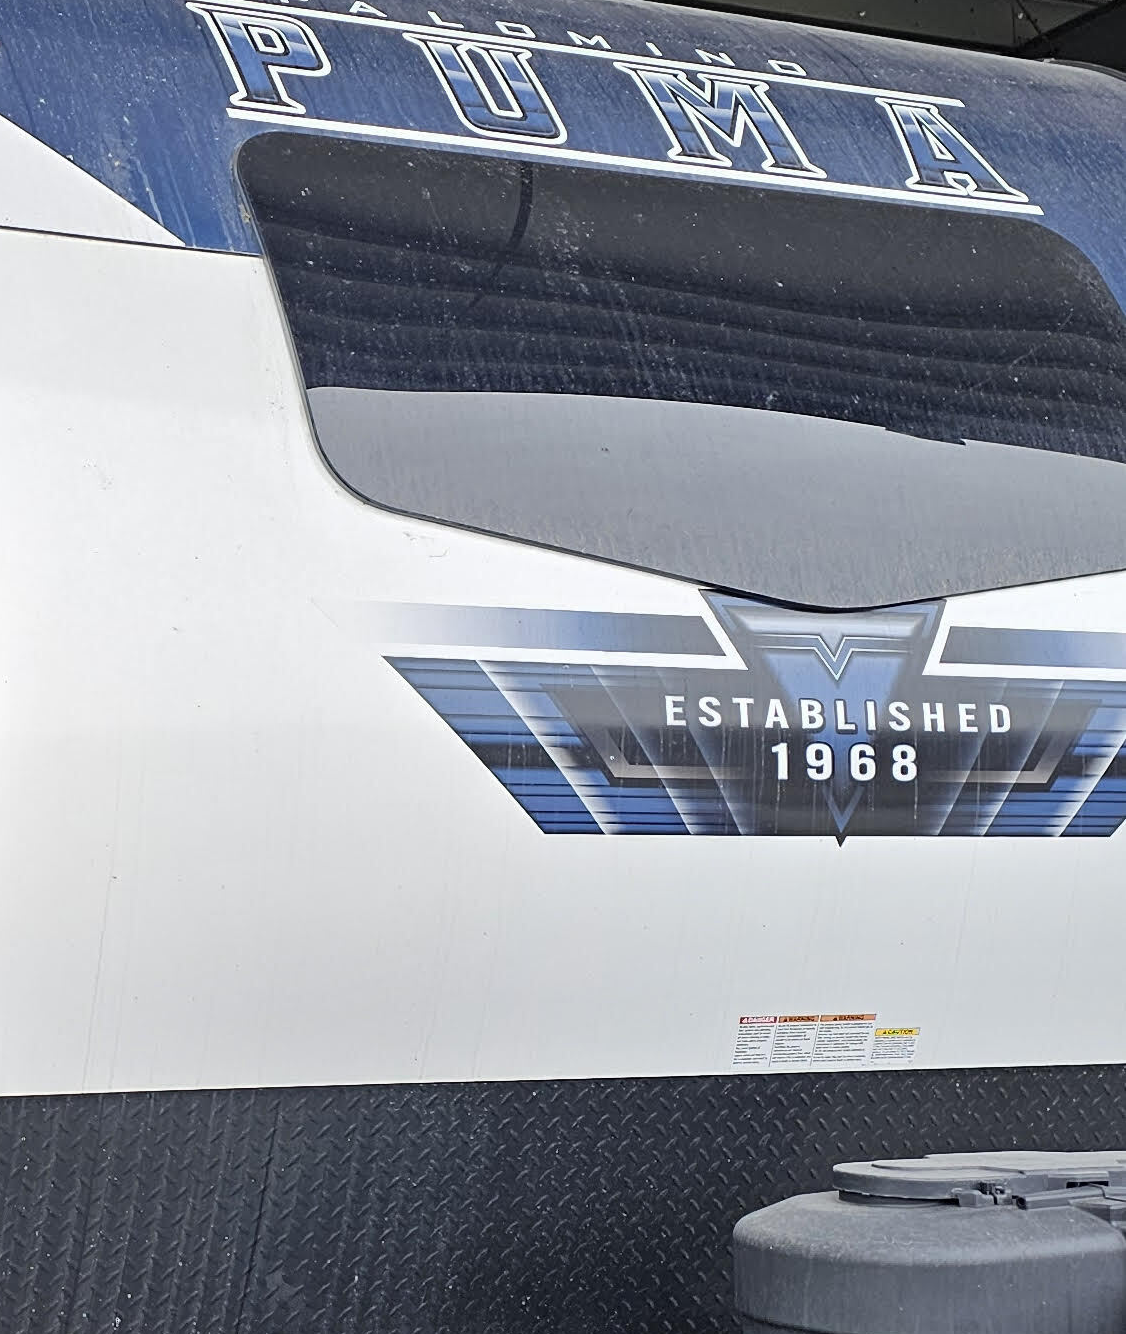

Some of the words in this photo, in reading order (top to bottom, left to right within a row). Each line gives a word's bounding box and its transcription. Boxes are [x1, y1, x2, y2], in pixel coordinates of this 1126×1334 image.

[187, 2, 1031, 204] PUMA
[664, 695, 1013, 734] ESTABLISHED
[771, 741, 919, 783] 1968
